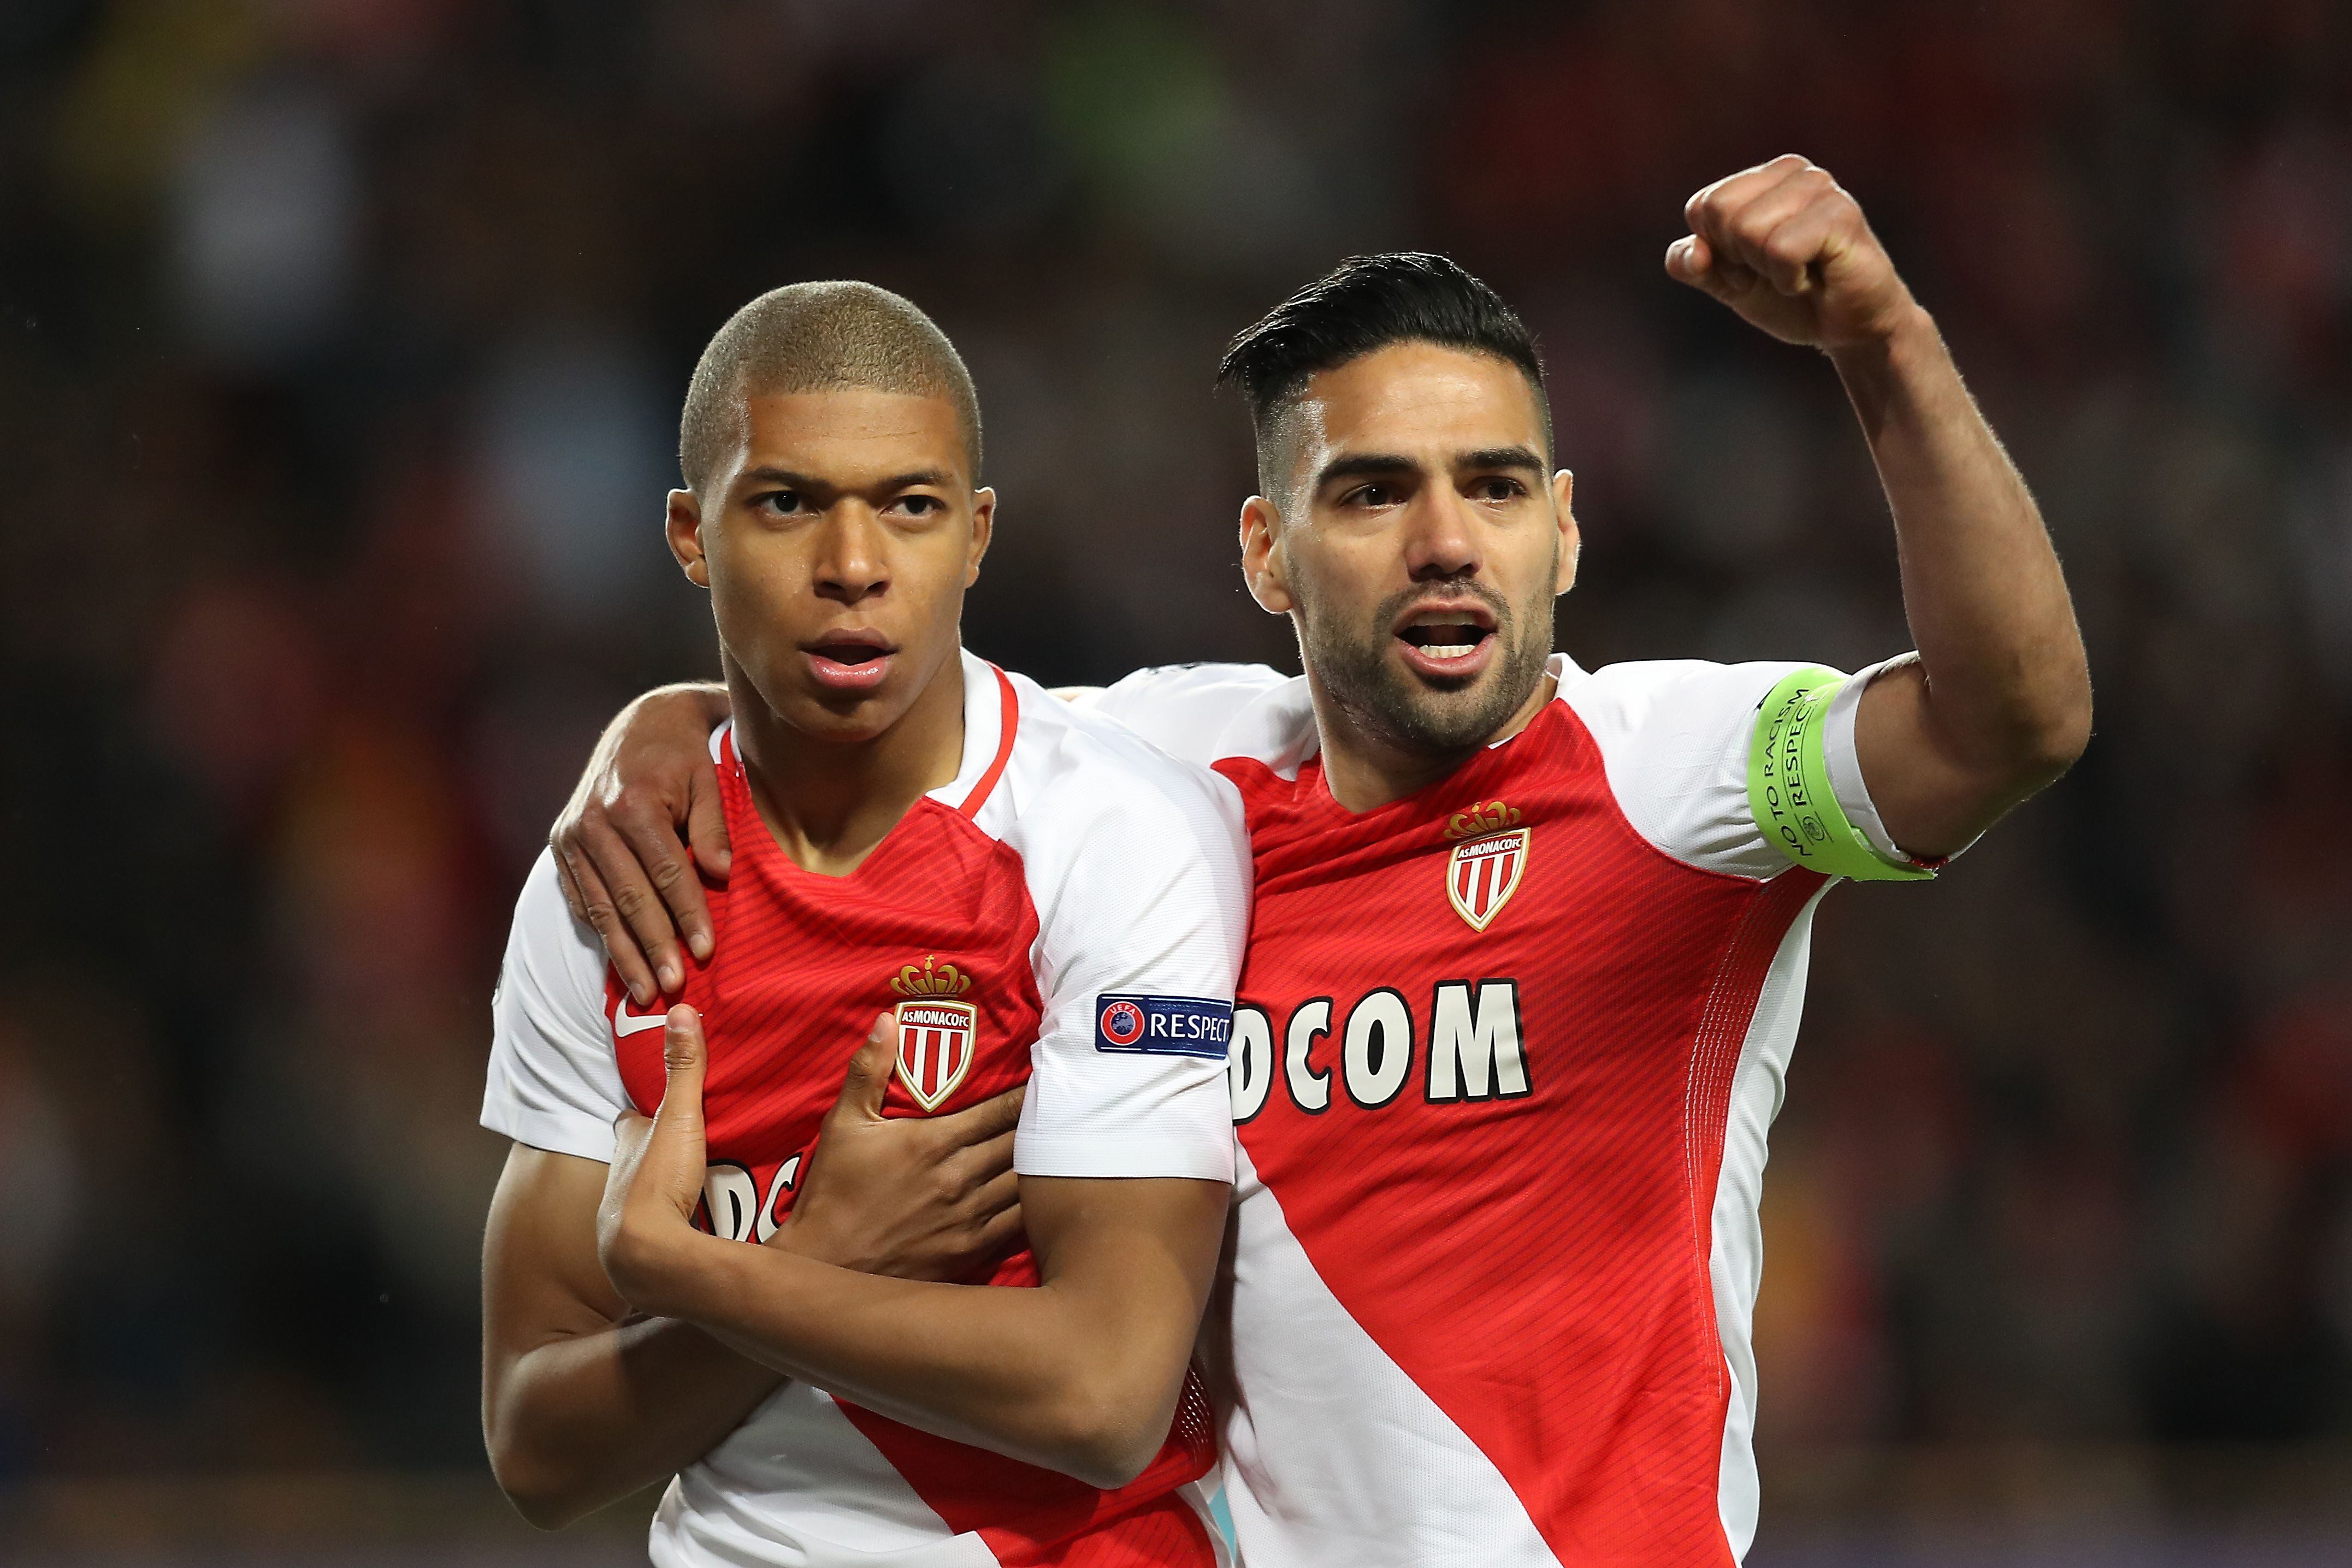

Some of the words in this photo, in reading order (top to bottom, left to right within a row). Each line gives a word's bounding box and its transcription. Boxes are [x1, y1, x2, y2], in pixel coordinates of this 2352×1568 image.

[1764, 689, 1810, 777] RACISM
[1767, 785, 1784, 820] TO
[1781, 825, 1812, 856] NO
[1109, 1004, 1136, 1015] UEFA
[1150, 1013, 1230, 1043] RESPECT
